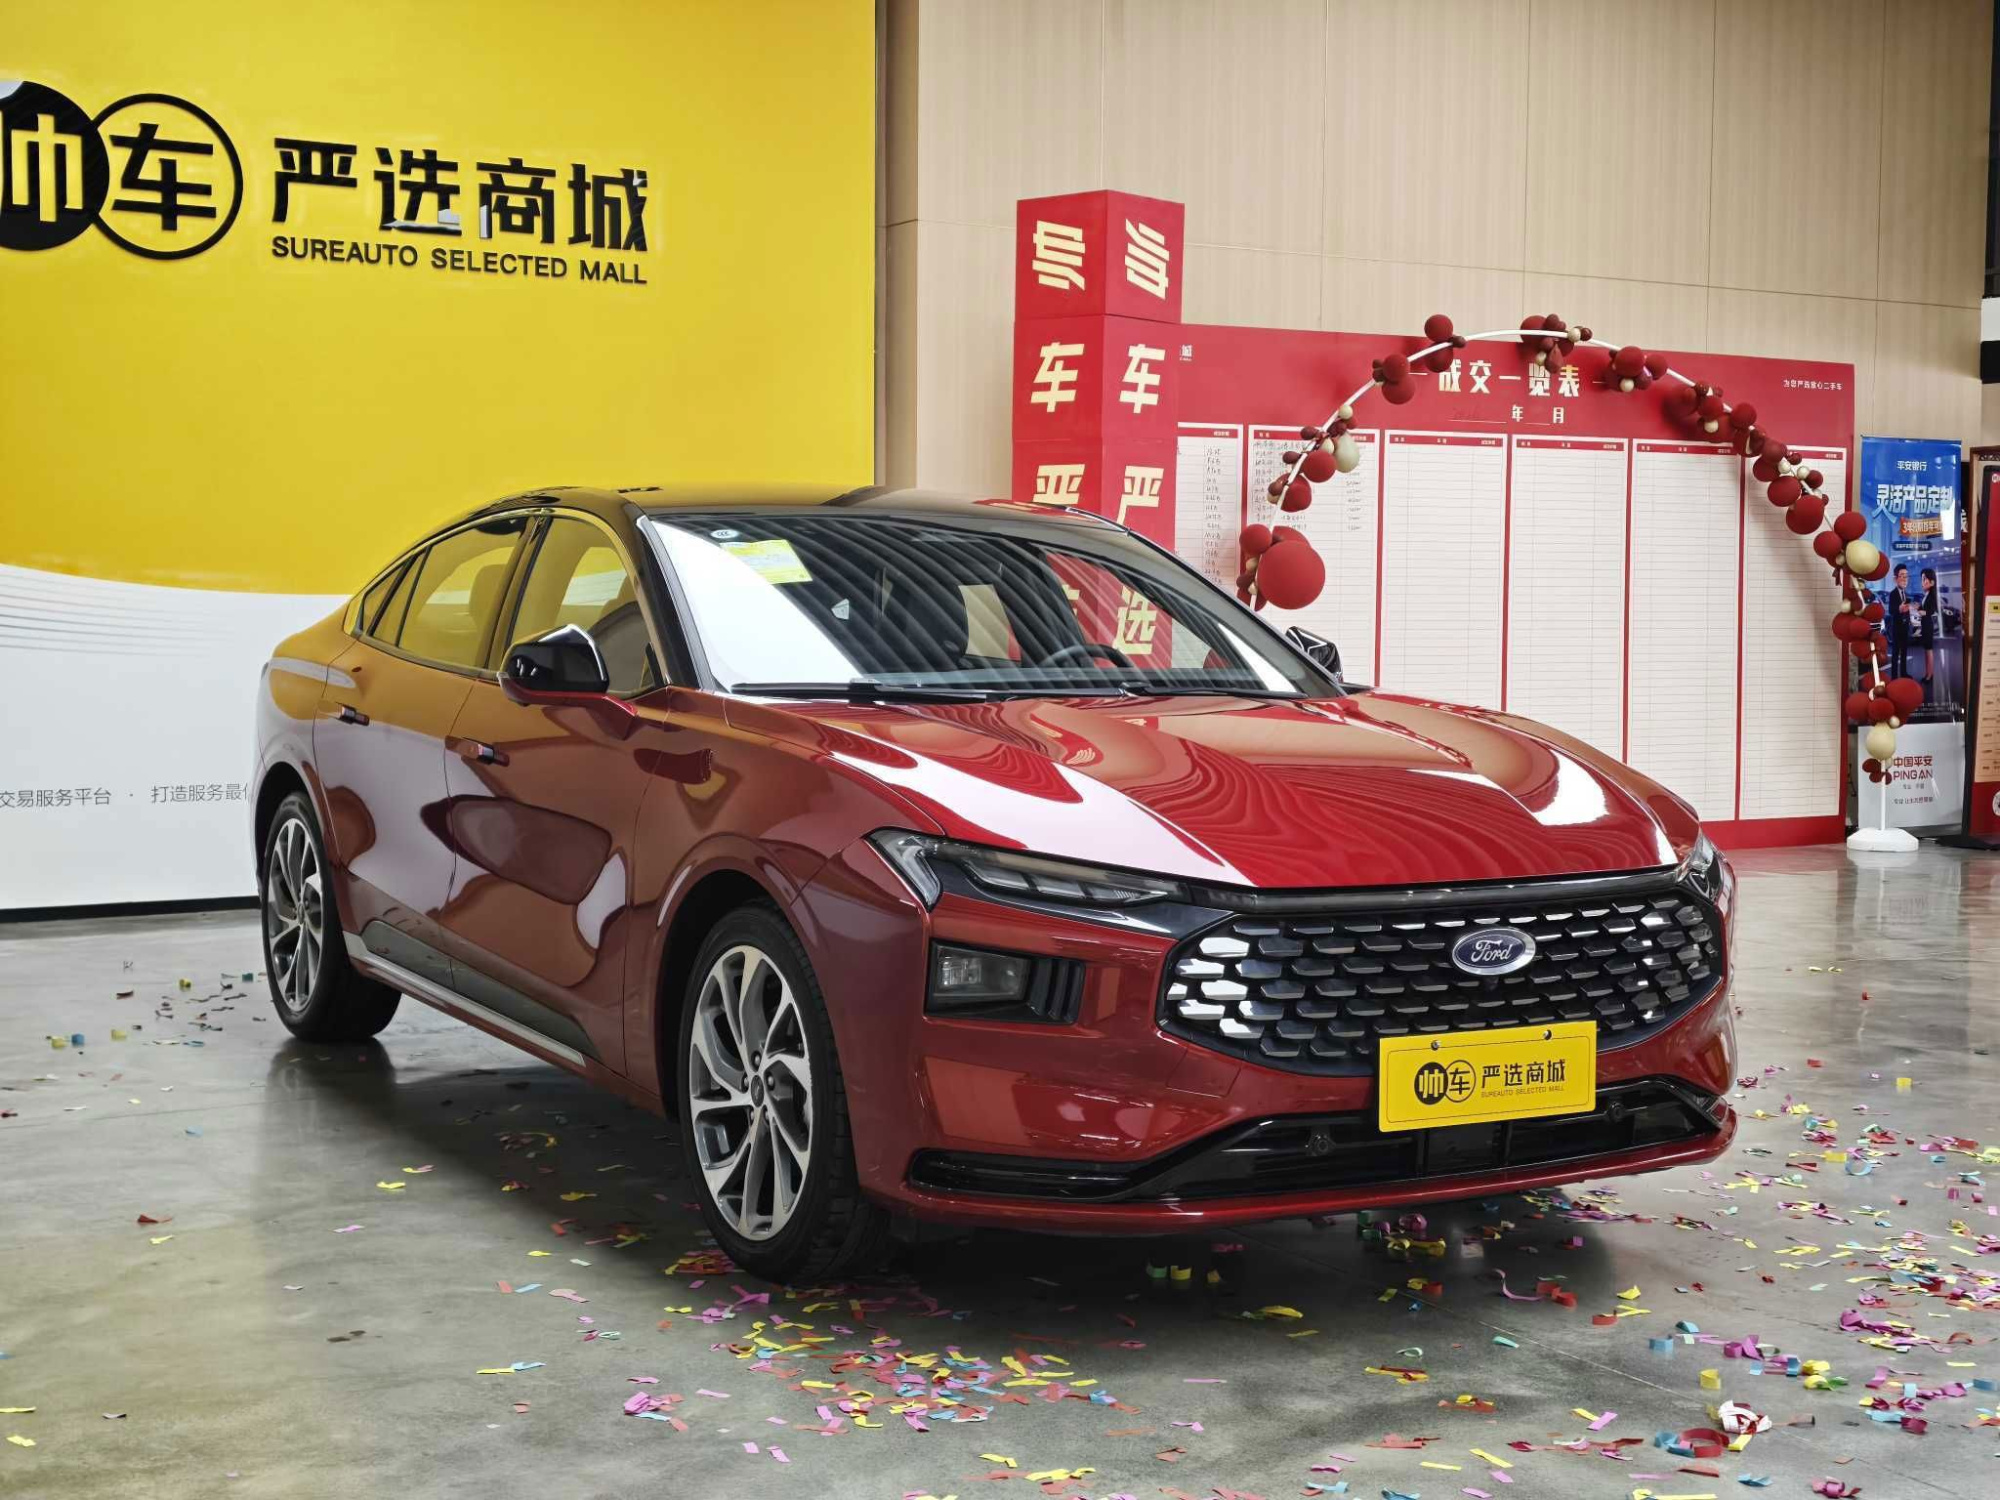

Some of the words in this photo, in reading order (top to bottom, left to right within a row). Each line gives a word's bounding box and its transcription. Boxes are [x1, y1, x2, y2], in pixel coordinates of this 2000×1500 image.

[271, 136, 649, 252] 严选商城
[271, 235, 419, 267] SUREAUTO
[430, 246, 568, 279] SELECTED
[578, 259, 648, 285] MALL
[1511, 404, 1524, 422] 年
[1552, 406, 1565, 424] 月
[1896, 460, 1928, 472] 平安银行
[1893, 755, 1934, 768] 中国平安
[0, 787, 112, 809] 交易服务平台
[1470, 938, 1513, 963] Ford
[1418, 1067, 1471, 1099] 帅车
[1480, 1058, 1566, 1090] 严选商城
